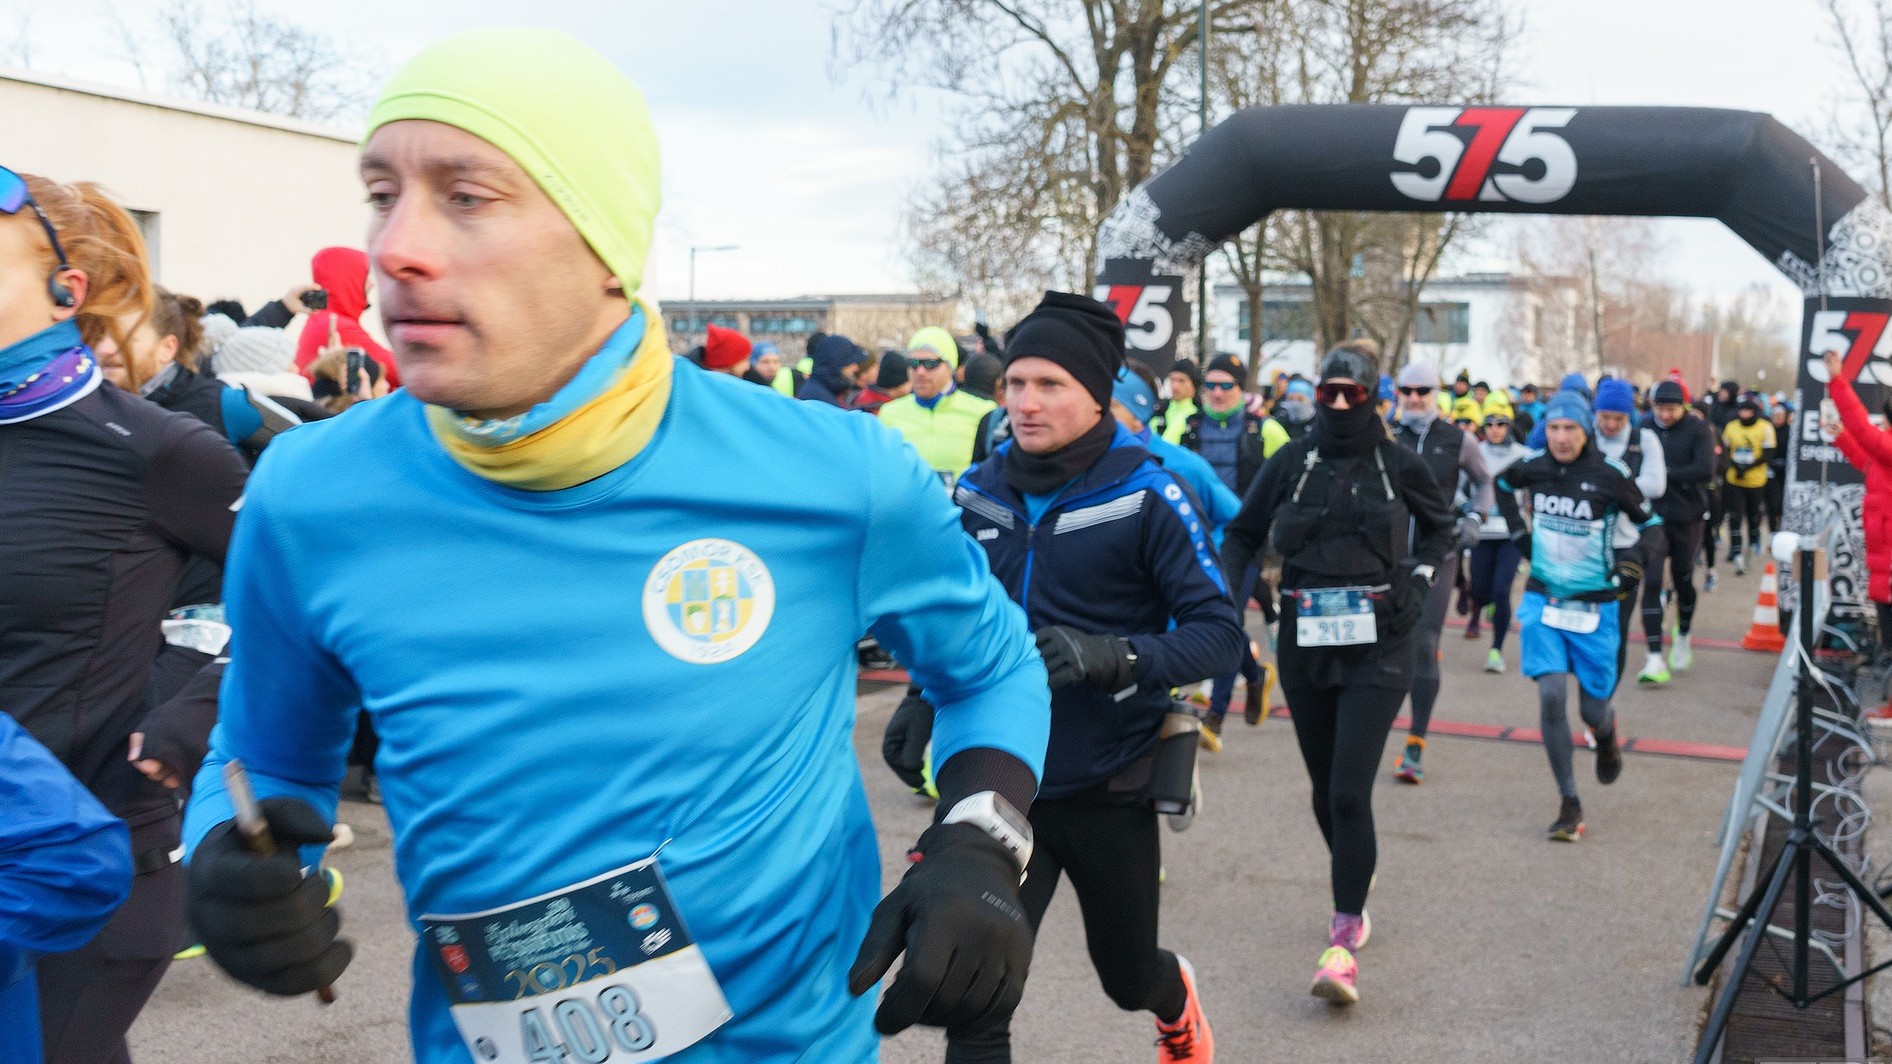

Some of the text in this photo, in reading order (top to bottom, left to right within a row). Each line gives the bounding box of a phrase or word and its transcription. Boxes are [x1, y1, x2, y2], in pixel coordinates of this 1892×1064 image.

[1389, 107, 1578, 203] 575
[1093, 284, 1173, 351] 75
[1533, 493, 1593, 520] BORA
[1318, 621, 1355, 641] 212
[503, 946, 617, 1000] 2025
[519, 984, 656, 1064] 408
